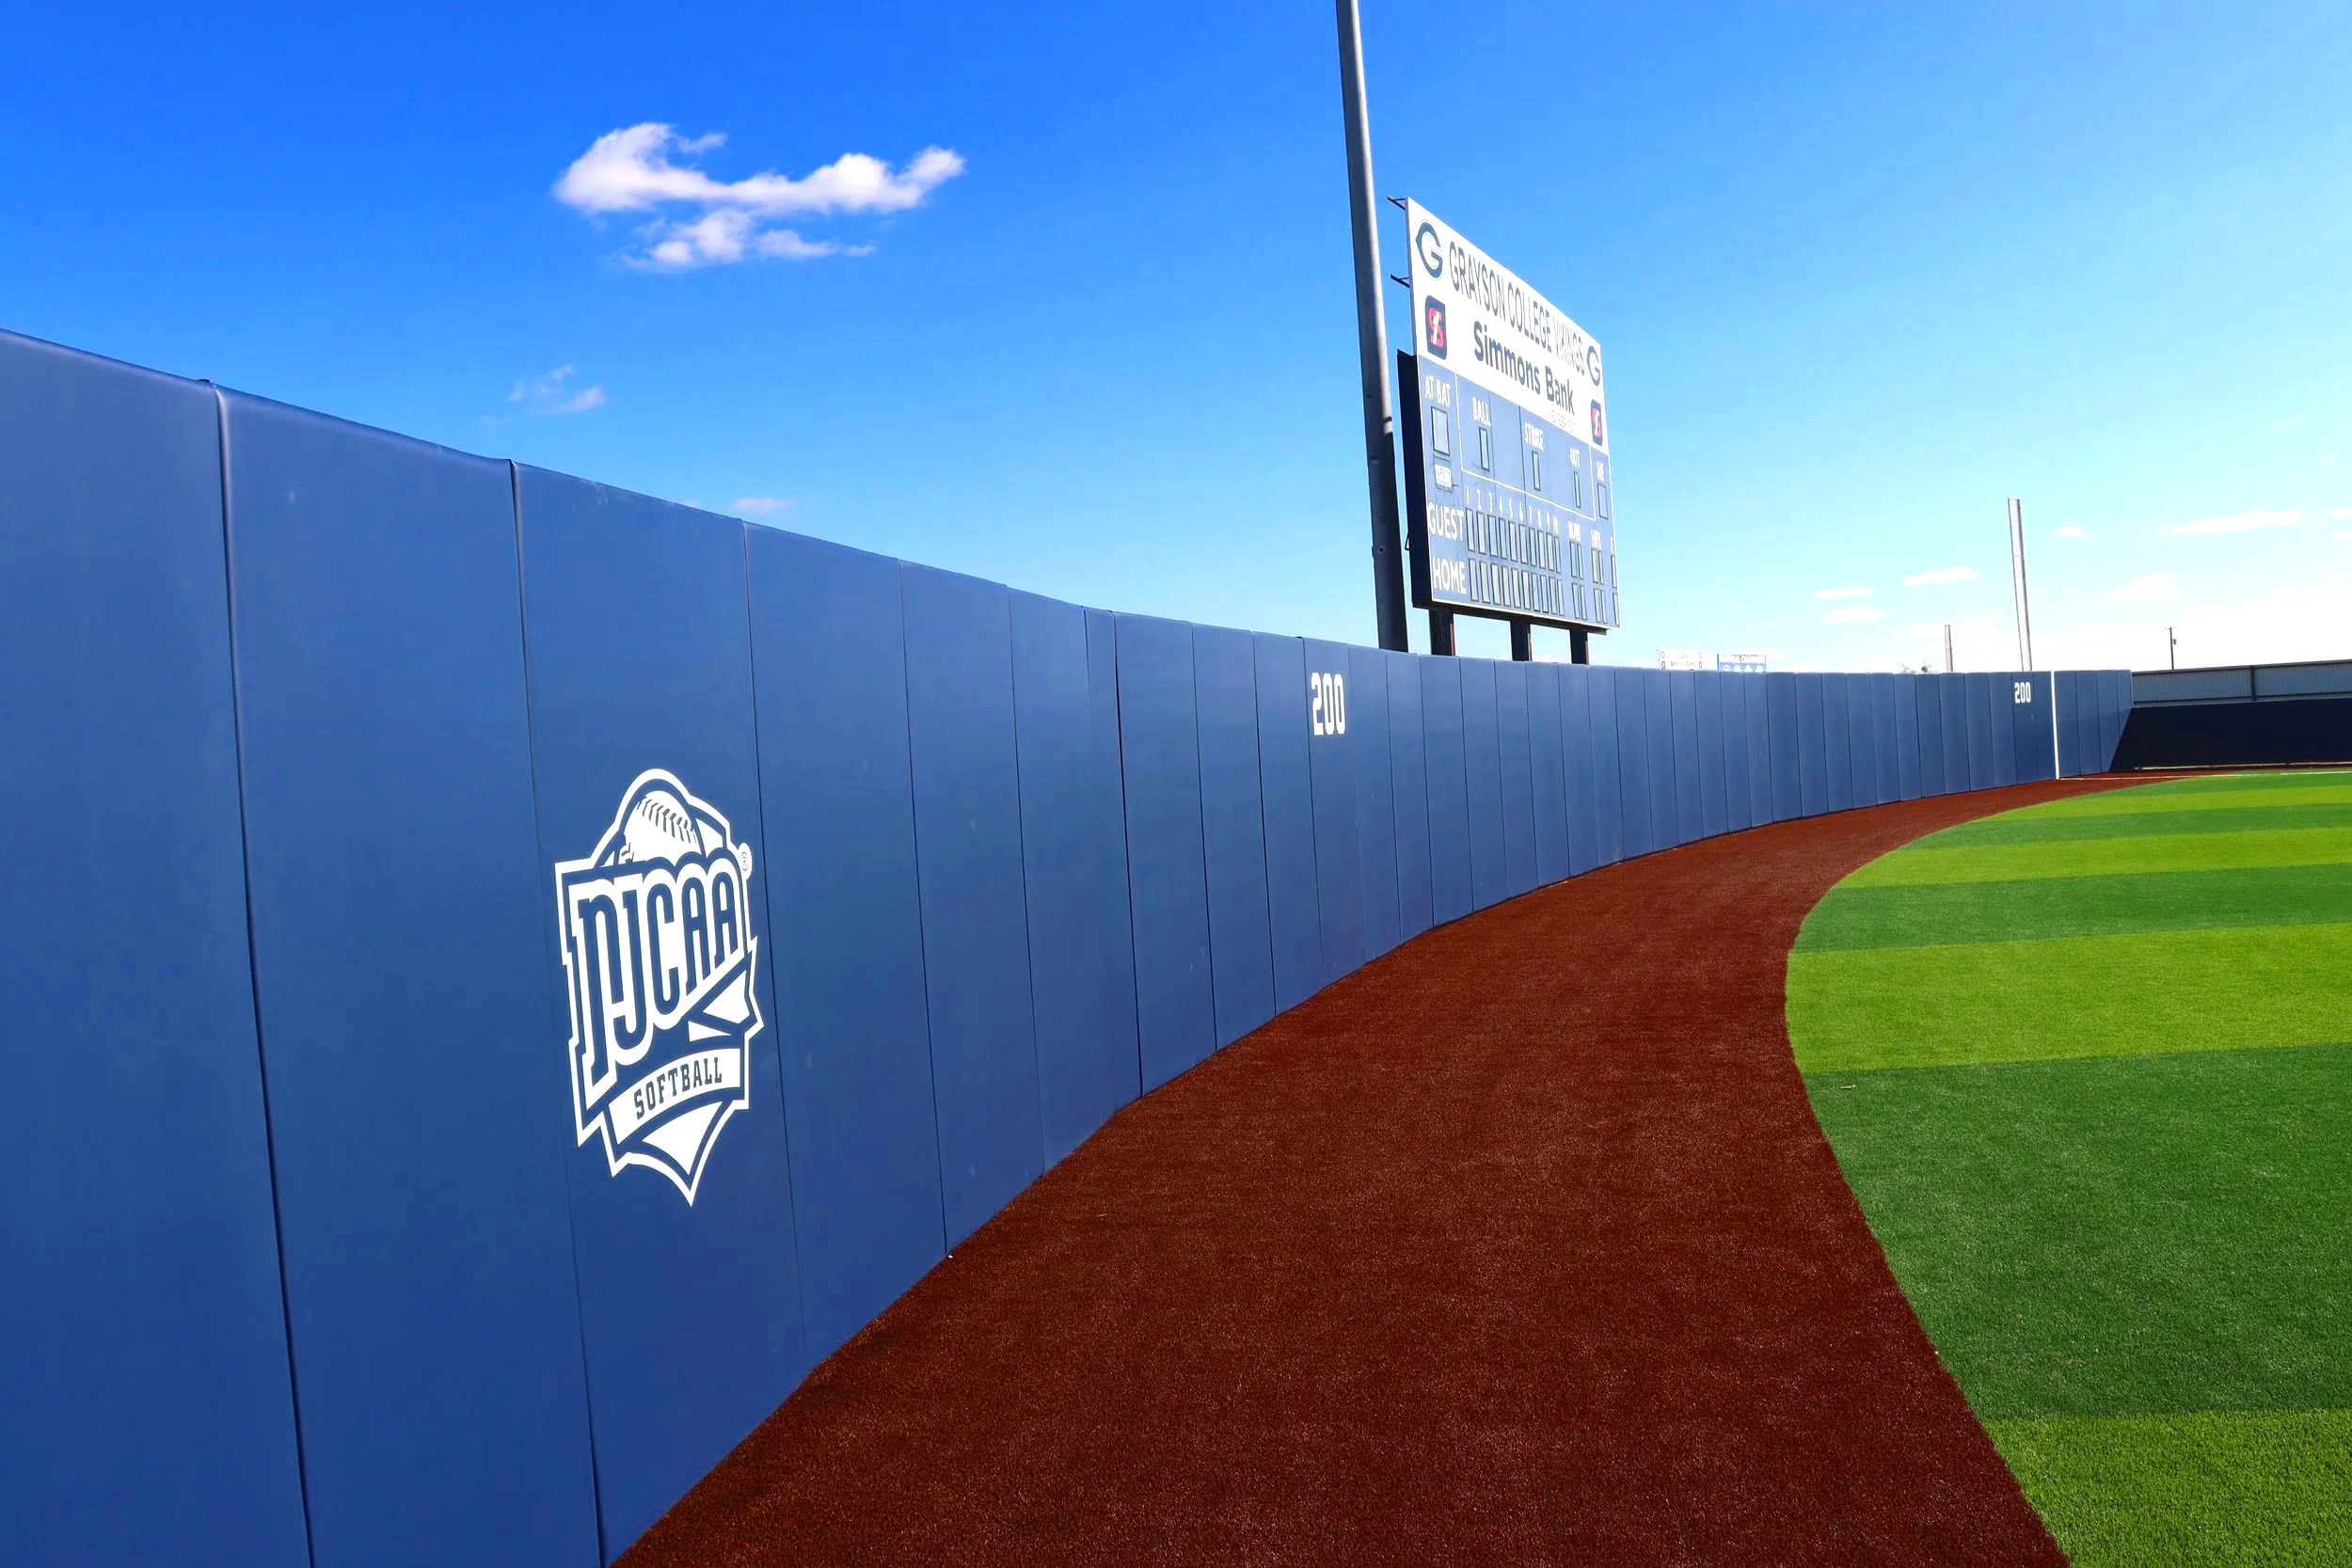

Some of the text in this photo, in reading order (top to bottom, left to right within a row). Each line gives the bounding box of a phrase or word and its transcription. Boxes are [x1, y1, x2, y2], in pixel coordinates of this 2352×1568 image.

[1449, 240, 1585, 376] GRAYSON COLLEGE VIKINGS
[1473, 320, 1575, 416] Simmons Bank
[1425, 373, 1451, 407] AT BAT
[1472, 396, 1491, 427] BALL
[1427, 501, 1464, 542] GUEST
[1476, 488, 1483, 511] 2
[1487, 491, 1493, 514] 3
[1508, 499, 1514, 519] 5
[1432, 556, 1467, 594] HOME
[1311, 672, 1346, 736] 200
[2014, 681, 2031, 704] 200
[578, 871, 739, 1087] NJCAA
[633, 1056, 723, 1121] SOFTBALL
